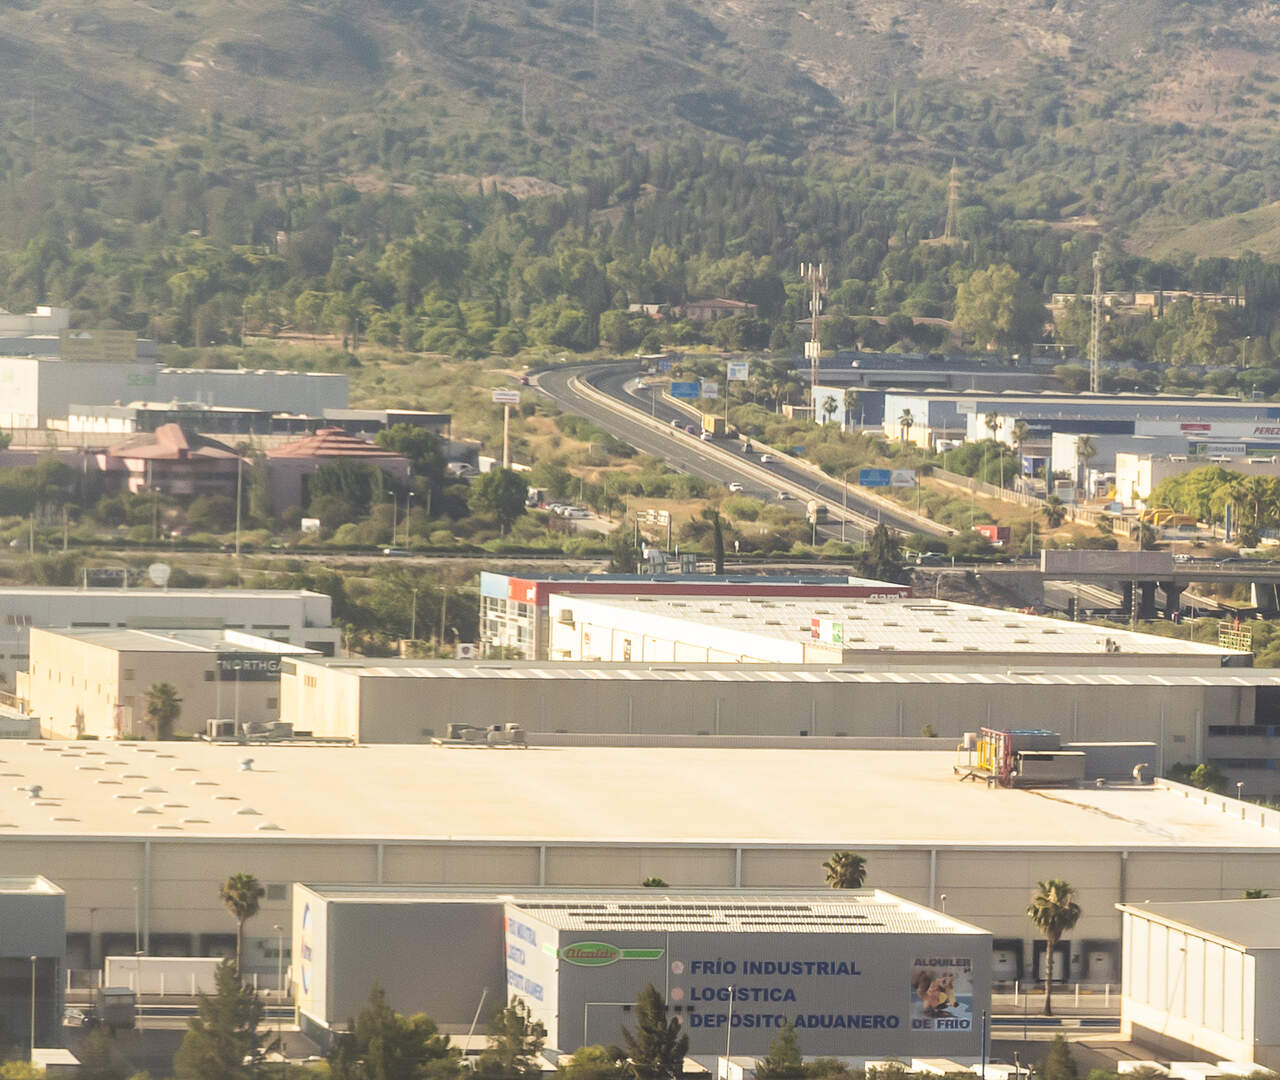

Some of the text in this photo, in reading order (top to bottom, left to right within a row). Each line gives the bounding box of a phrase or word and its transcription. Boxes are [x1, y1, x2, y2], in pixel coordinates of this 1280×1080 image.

[691, 958, 861, 976] FRÍO INDUSTRIAL
[914, 958, 971, 967] ALQUILER
[691, 985, 797, 1002] LOGÍSTICA
[794, 1014, 900, 1029] ADUANERO
[912, 1019, 931, 1029] DE
